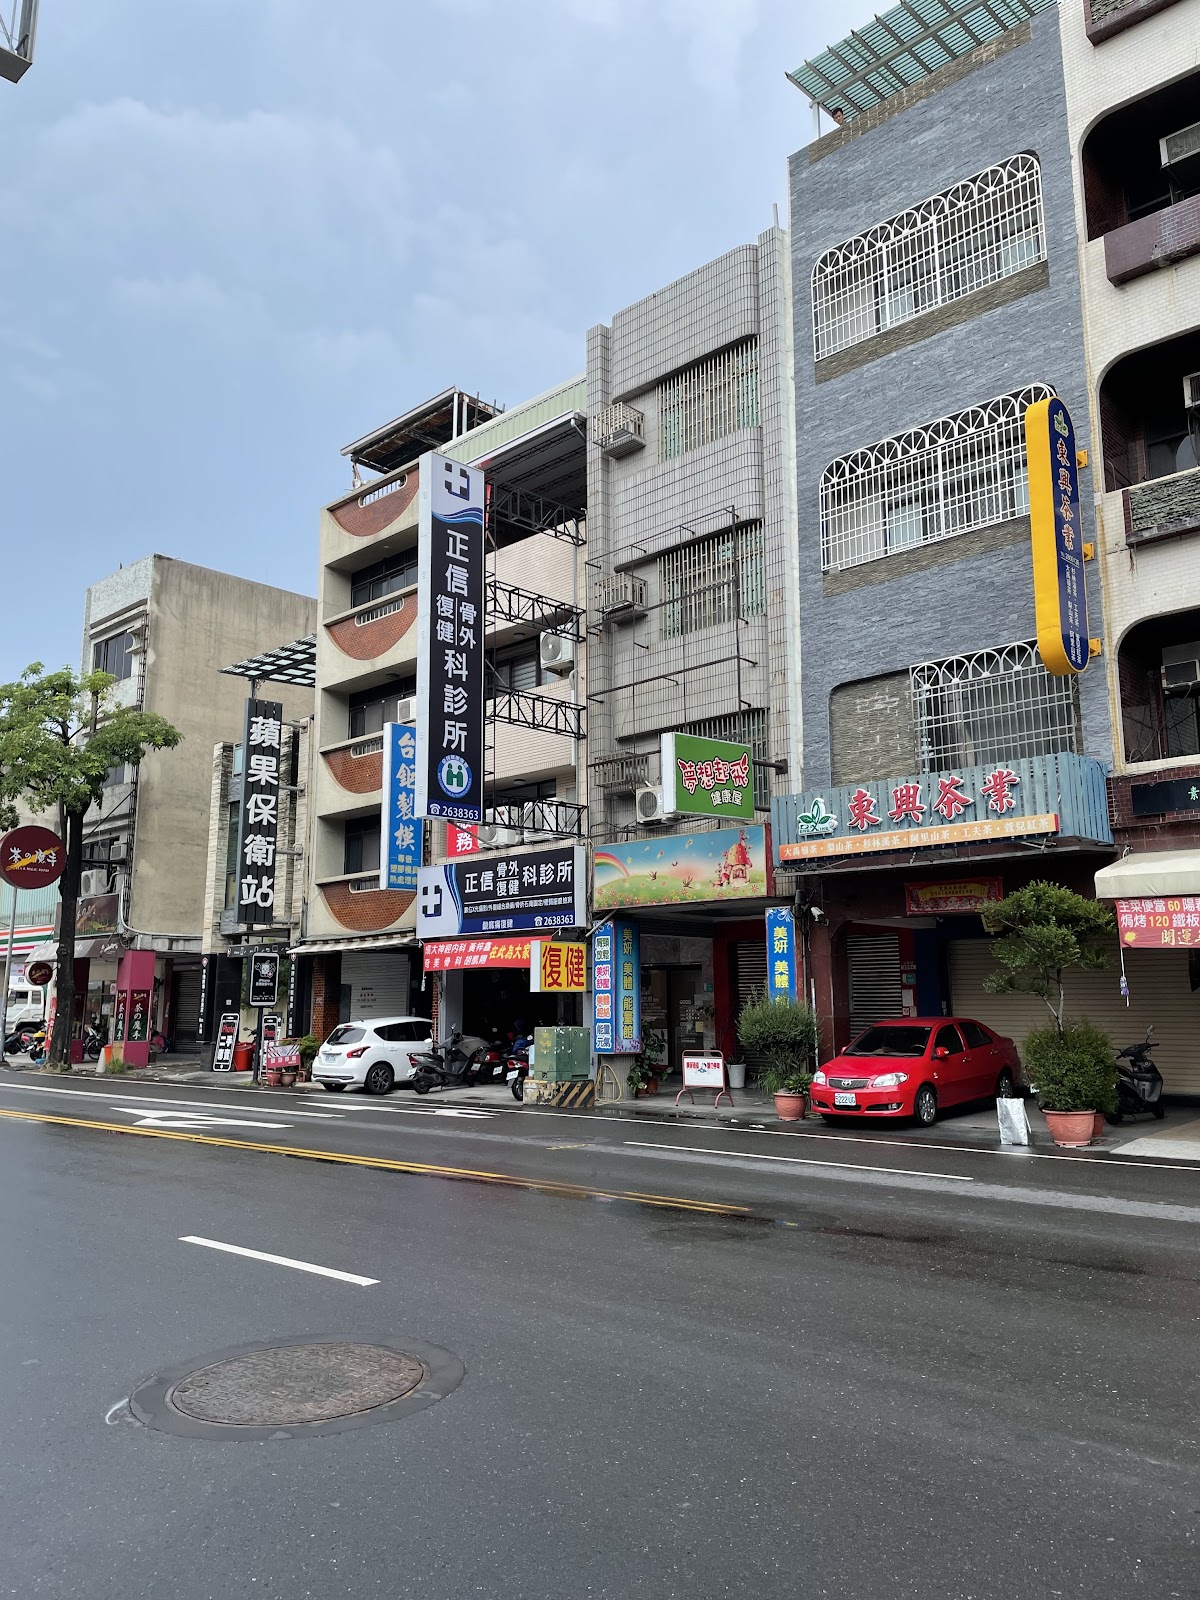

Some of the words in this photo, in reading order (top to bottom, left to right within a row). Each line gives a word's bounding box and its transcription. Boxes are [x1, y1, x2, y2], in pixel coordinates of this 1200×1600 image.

[445, 529, 469, 597] 正信
[436, 594, 454, 643] 復健
[459, 602, 477, 649] 骨外
[442, 650, 468, 752] 科診所
[678, 753, 749, 794] 夢想起飛
[240, 716, 280, 907] 蘋果保衛站
[442, 806, 479, 820] 2638363
[711, 790, 742, 806] 健康屋
[847, 769, 1020, 831] 東興茶業
[464, 870, 494, 894] 正信
[496, 860, 519, 878] 骨外
[522, 860, 573, 887] 科診所
[496, 879, 519, 897] 復健
[543, 914, 574, 926] 2638363
[1149, 915, 1169, 927] 120
[1167, 901, 1181, 912] 60
[774, 926, 788, 953] 美妍
[542, 945, 585, 988] 復健
